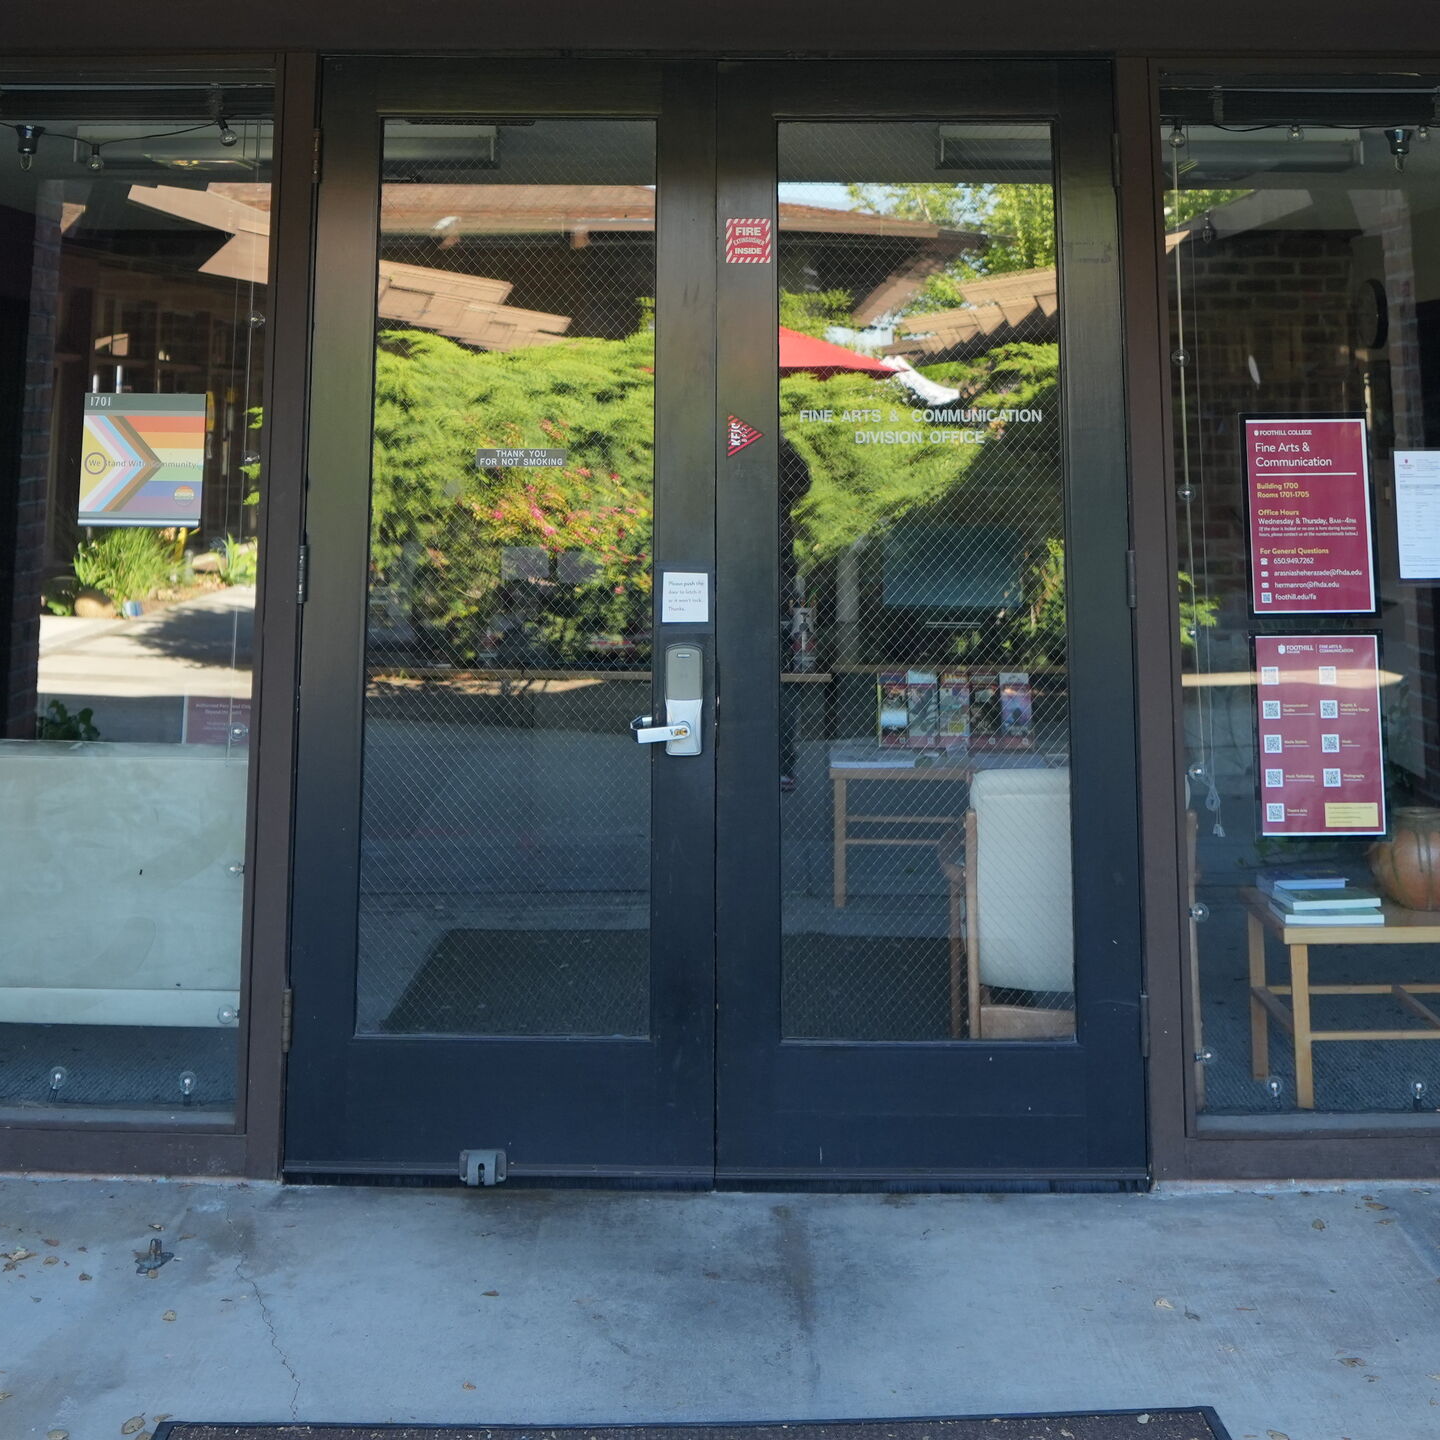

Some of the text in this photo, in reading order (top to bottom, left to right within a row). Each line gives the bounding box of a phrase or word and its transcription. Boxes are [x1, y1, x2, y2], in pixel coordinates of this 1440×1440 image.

[735, 226, 763, 237] FIRE
[734, 247, 763, 255] INSIDE
[800, 409, 1043, 423] FINE ARTS & COMMUNICATION
[731, 423, 741, 446] KFJC
[855, 430, 986, 445] DIVISION OFFICE
[1255, 441, 1311, 453] Fine Arts &
[496, 450, 547, 458] THANK YOU
[479, 458, 564, 466] FOR NOT SMOKING
[1255, 457, 1332, 467] Communication
[1256, 481, 1299, 491] Building 1700
[1257, 490, 1310, 498] Rooms 1701-1705
[1258, 517, 1293, 525] Wednesday
[1302, 517, 1328, 525] Thursday,
[1272, 547, 1297, 555] General
[1298, 547, 1329, 556] Questions
[1286, 644, 1314, 652] FOOTHILL
